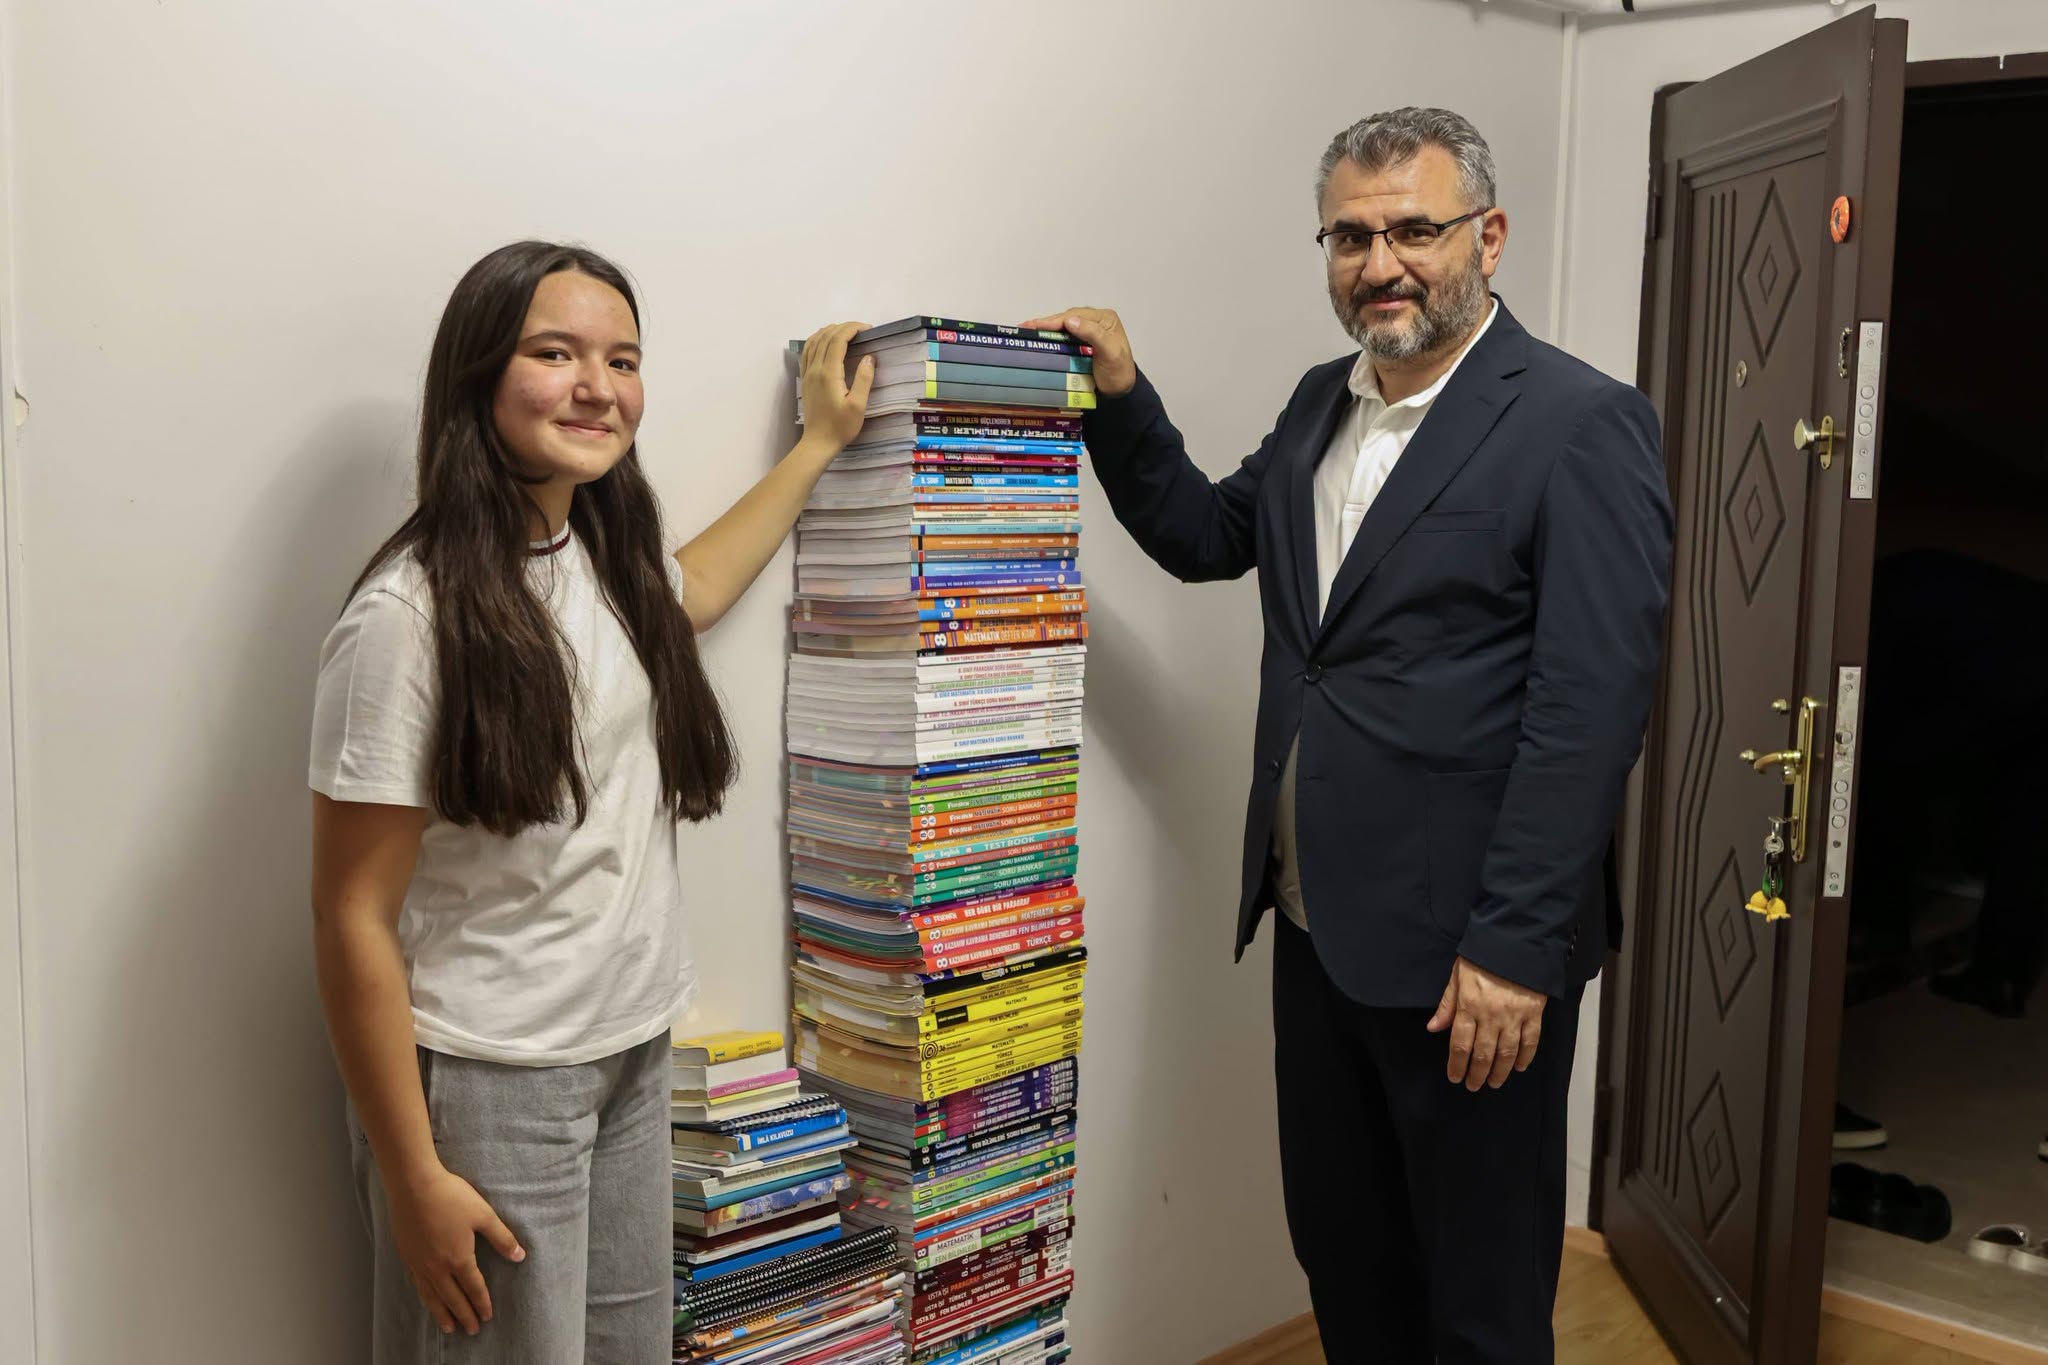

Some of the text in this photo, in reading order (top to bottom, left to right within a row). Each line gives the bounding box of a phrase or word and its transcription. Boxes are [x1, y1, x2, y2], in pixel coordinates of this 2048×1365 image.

[960, 334, 1002, 345] PARAGRAF
[1006, 338, 1025, 348] SORU
[1028, 340, 1060, 351] BANKASI
[936, 1233, 974, 1250] MATEMATİK
